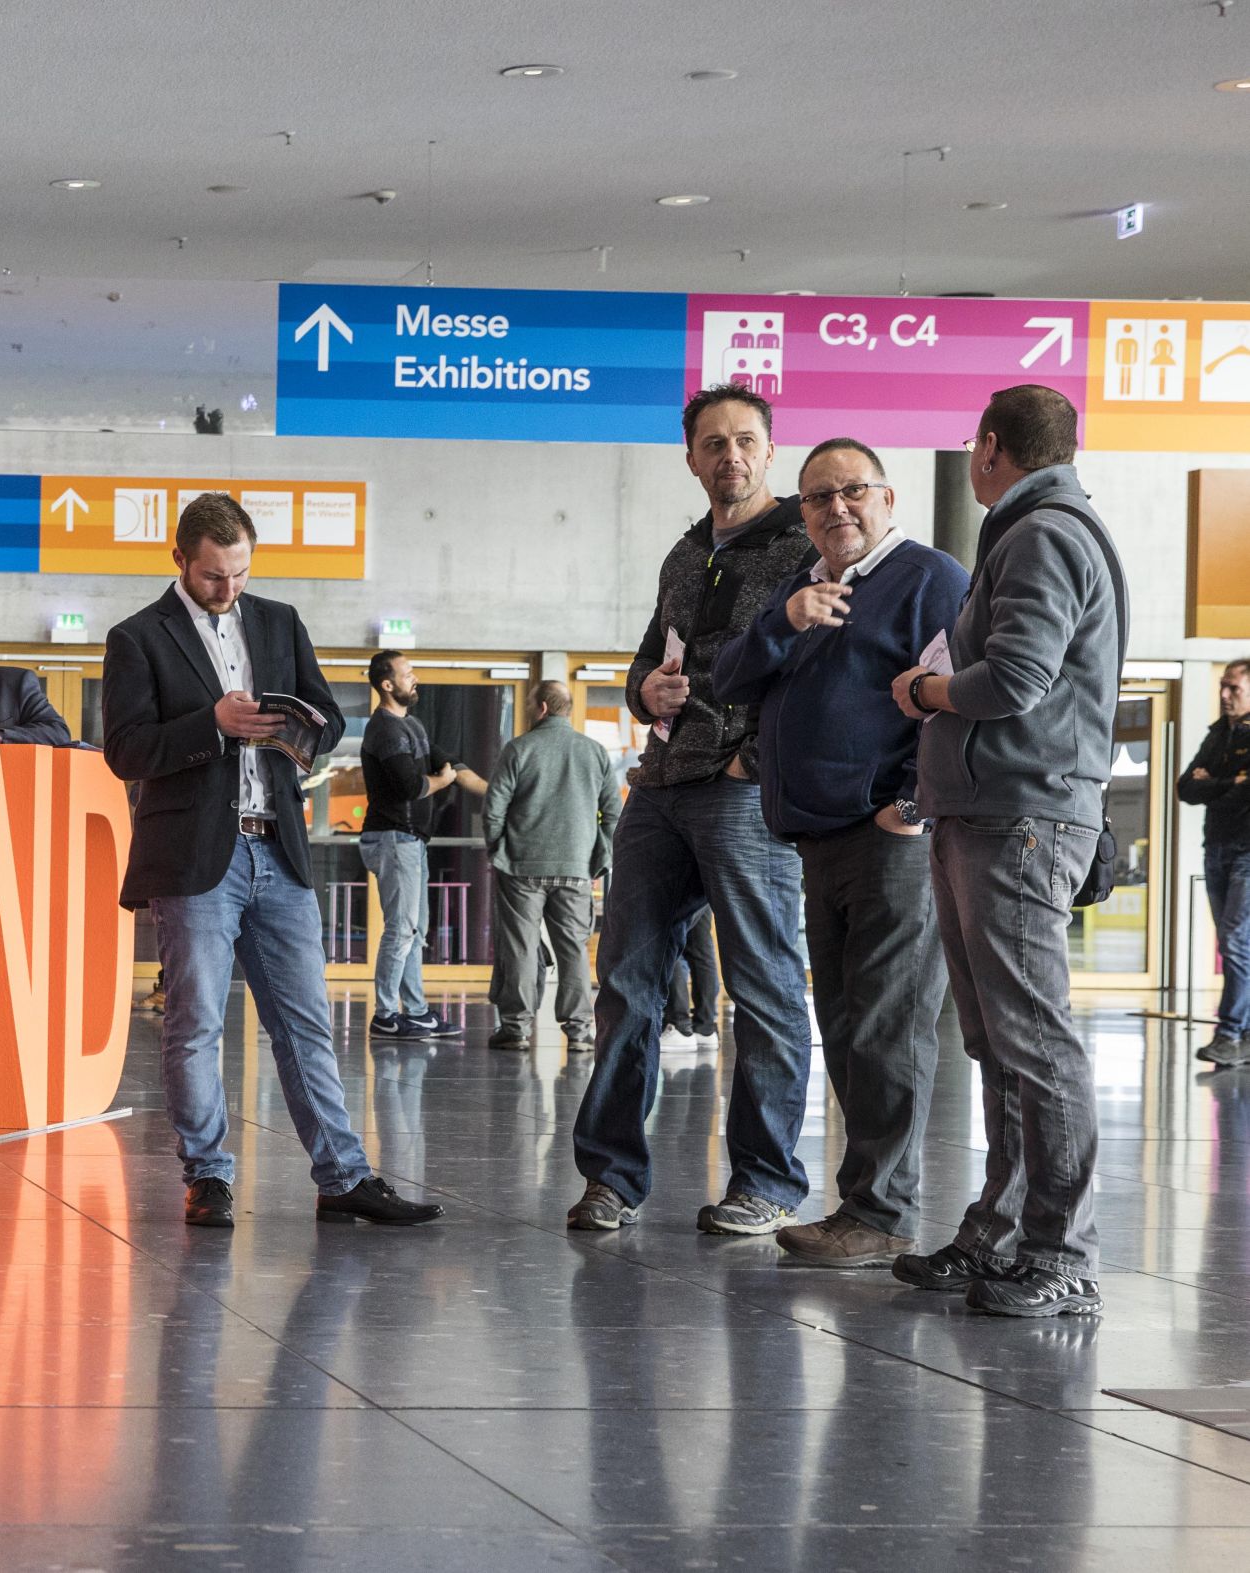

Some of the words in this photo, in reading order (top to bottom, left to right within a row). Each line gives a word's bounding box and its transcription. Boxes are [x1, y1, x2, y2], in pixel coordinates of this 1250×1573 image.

[396, 304, 509, 338] Messe
[819, 312, 878, 351] C3,
[889, 313, 940, 348] C4
[394, 354, 591, 392] Exhibitions
[244, 498, 289, 507] Restaurant
[257, 508, 275, 517] Park
[306, 500, 351, 508] Restaurant
